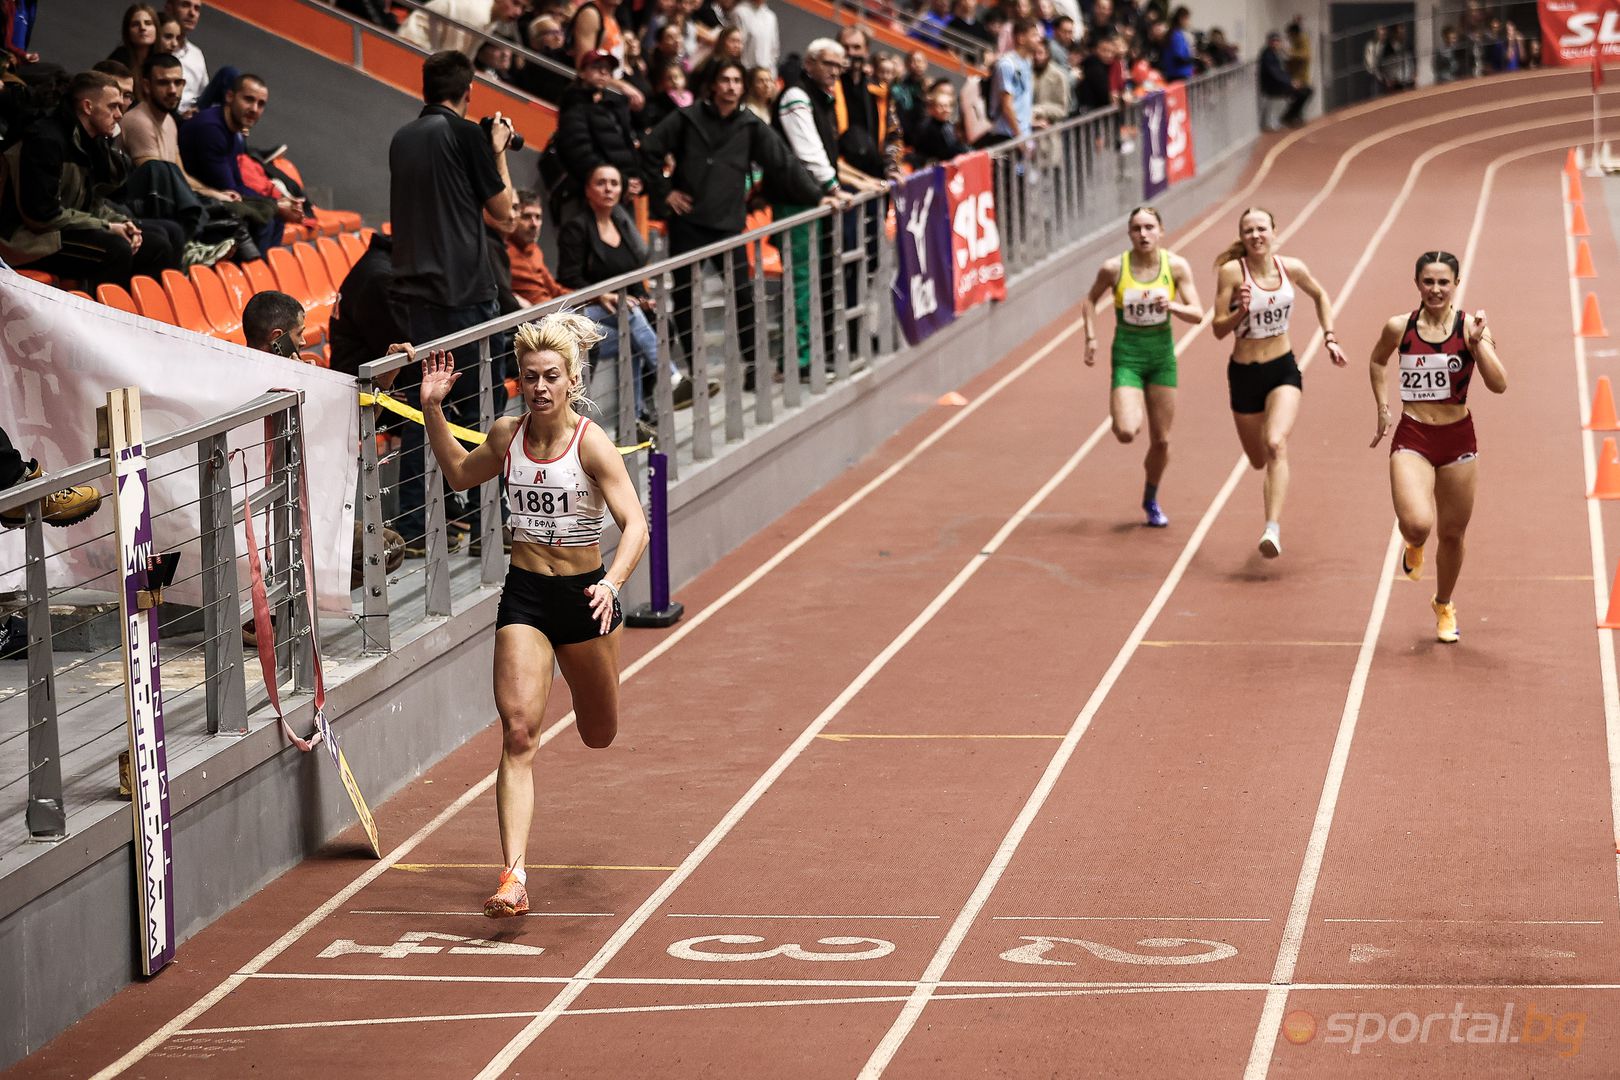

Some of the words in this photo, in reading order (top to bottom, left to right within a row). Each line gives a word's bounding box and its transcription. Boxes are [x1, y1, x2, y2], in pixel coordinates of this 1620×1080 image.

[1252, 304, 1290, 326] 1897
[1402, 371, 1446, 389] 2218
[533, 469, 547, 485] A1
[513, 489, 569, 515] 1881
[534, 519, 557, 529] БФЛА
[151, 641, 171, 876] TIMING
